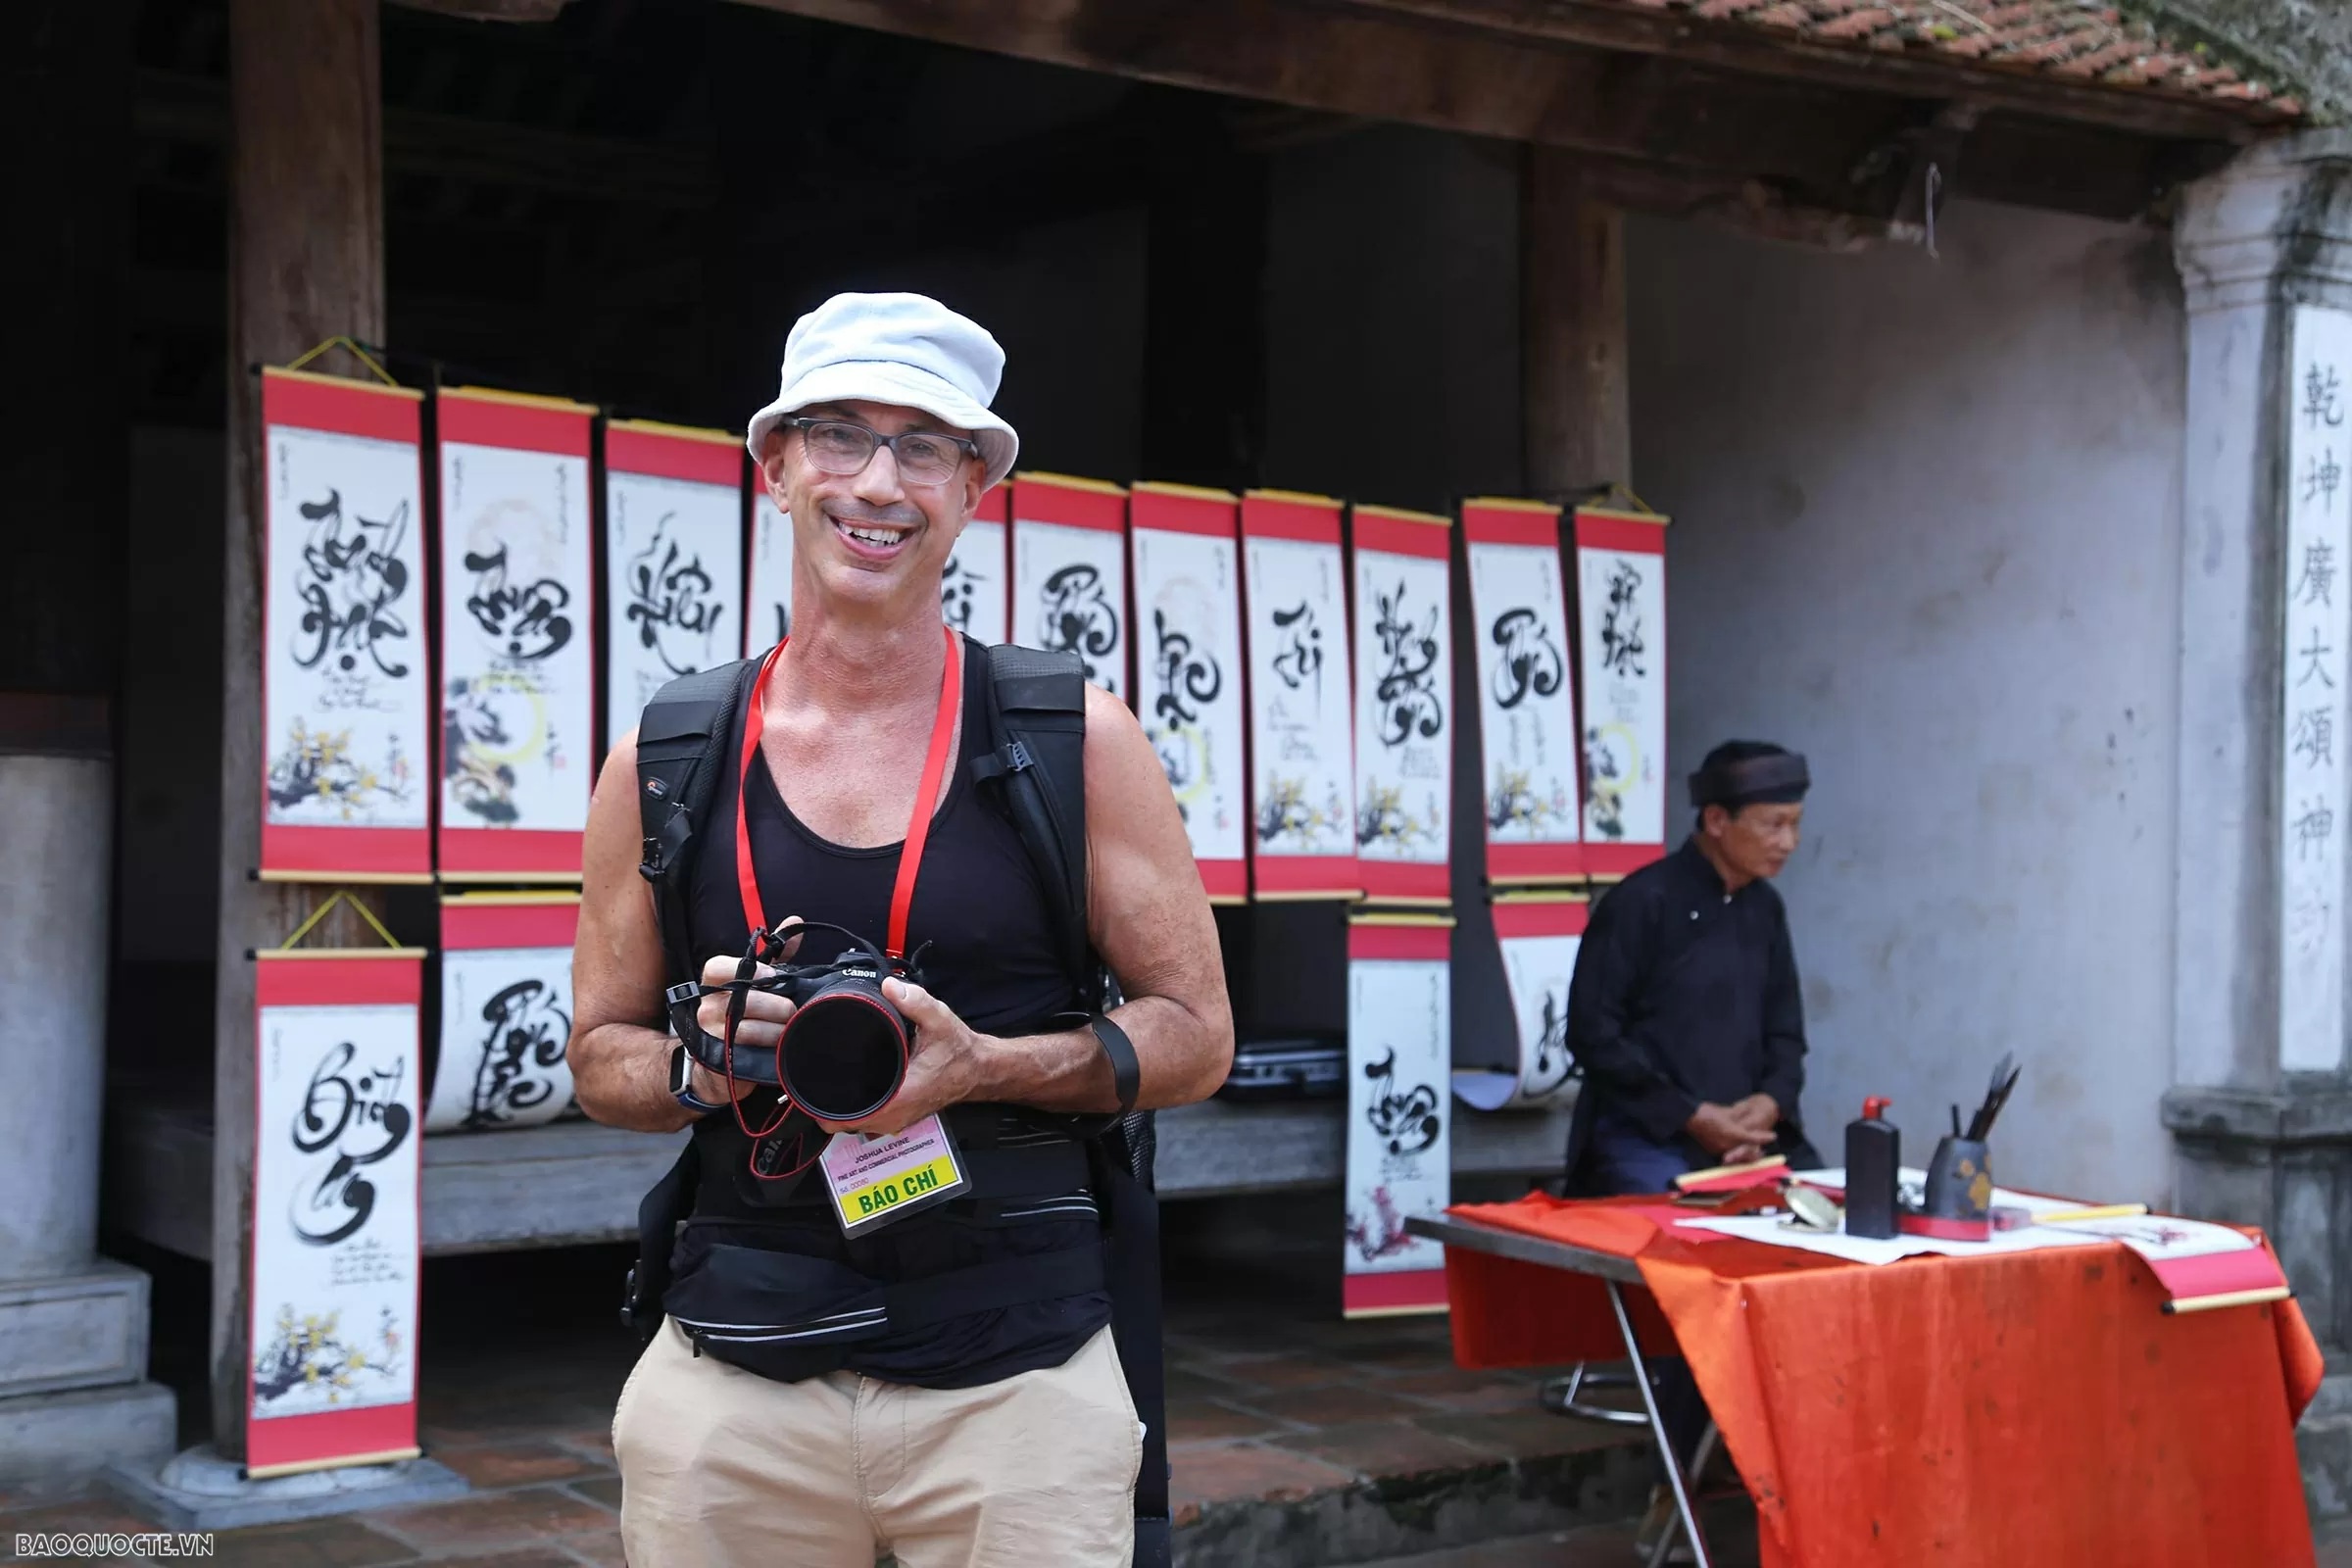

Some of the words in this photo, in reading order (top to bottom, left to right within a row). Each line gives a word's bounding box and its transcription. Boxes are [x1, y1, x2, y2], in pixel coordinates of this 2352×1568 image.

[842, 968, 877, 978] Canon
[855, 1148, 883, 1163] JOSHUA
[884, 1137, 910, 1152] LEVINE
[858, 1165, 868, 1174] AND
[868, 1153, 898, 1169] COMMERCIAL
[898, 1138, 935, 1156] PHOTOGRAPHER
[858, 1185, 899, 1214] BÁO
[903, 1164, 938, 1196] CHÍ
